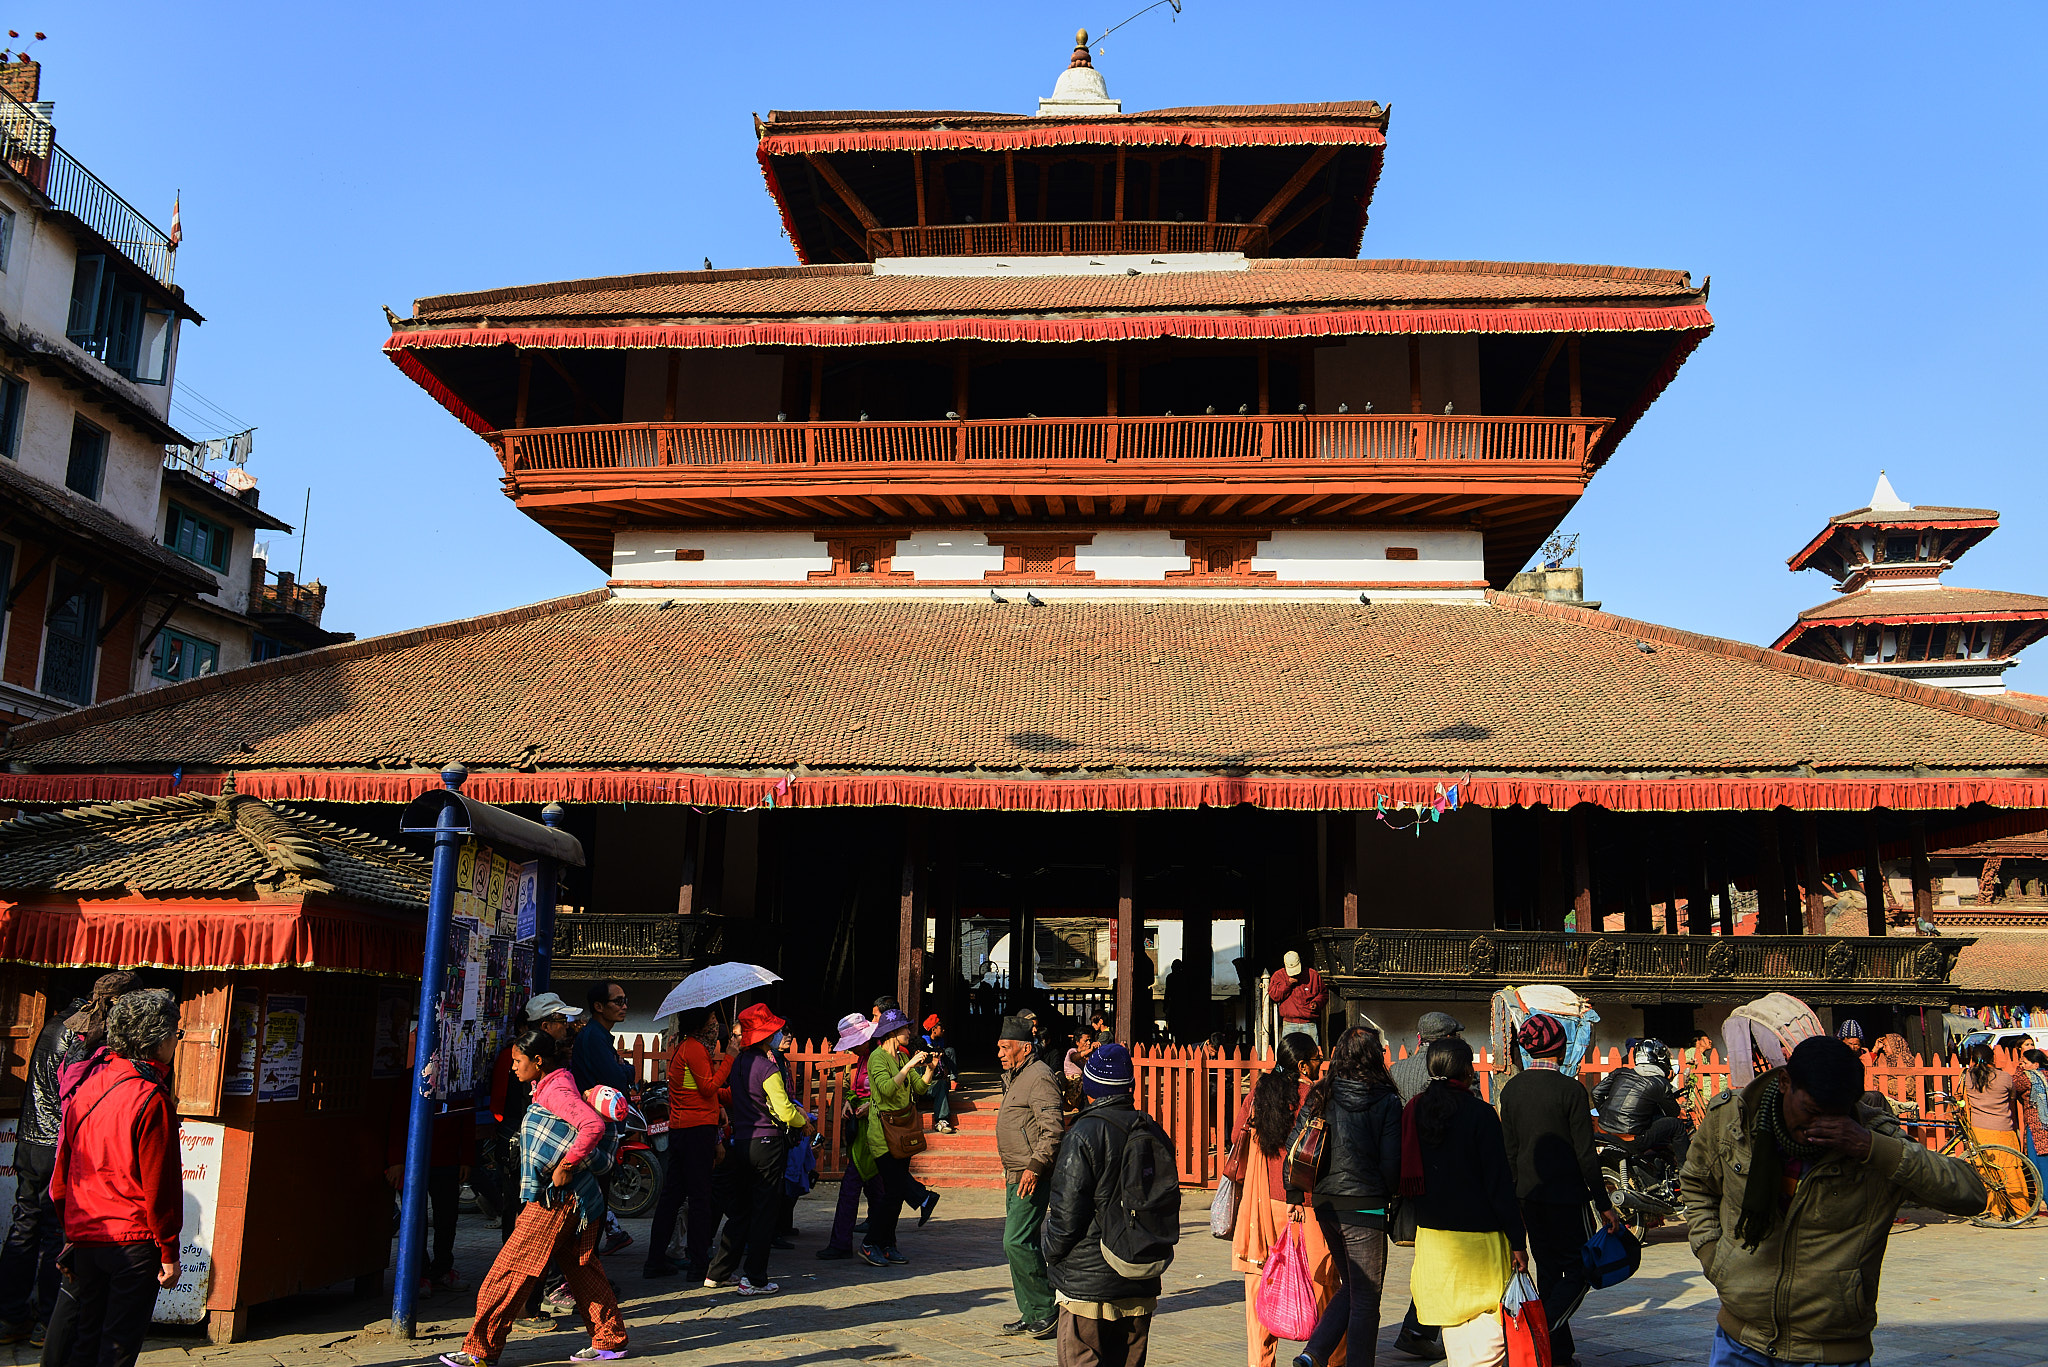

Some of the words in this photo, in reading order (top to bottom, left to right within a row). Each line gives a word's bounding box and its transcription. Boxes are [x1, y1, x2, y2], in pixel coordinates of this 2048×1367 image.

[181, 1163, 208, 1181] amiti
[182, 1243, 203, 1257] stay
[189, 1261, 207, 1273] with
